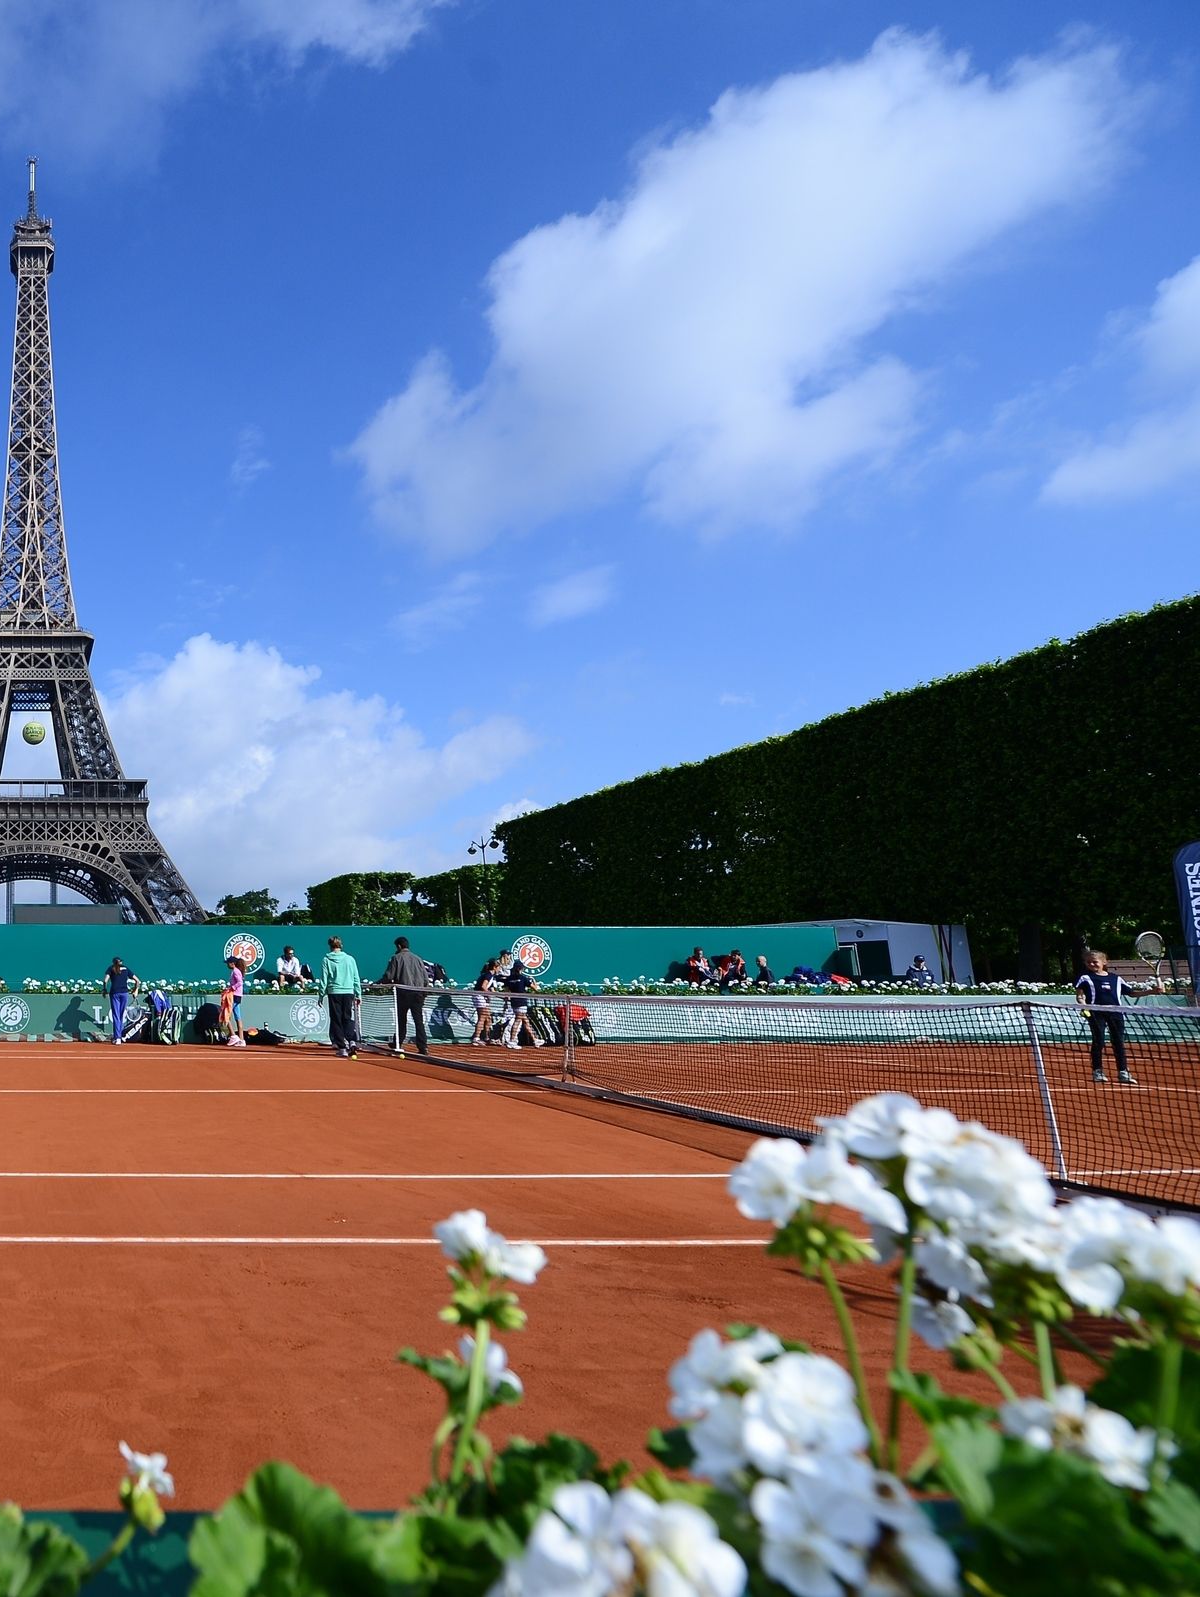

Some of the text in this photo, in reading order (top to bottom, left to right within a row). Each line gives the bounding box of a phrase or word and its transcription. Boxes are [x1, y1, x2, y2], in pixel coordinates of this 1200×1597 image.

[226, 935, 263, 959] ROLAND GARROS
[513, 937, 550, 960] ROLAND GARROS
[11, 997, 28, 1019] GARROS
[121, 1017, 149, 1043] HEAD
